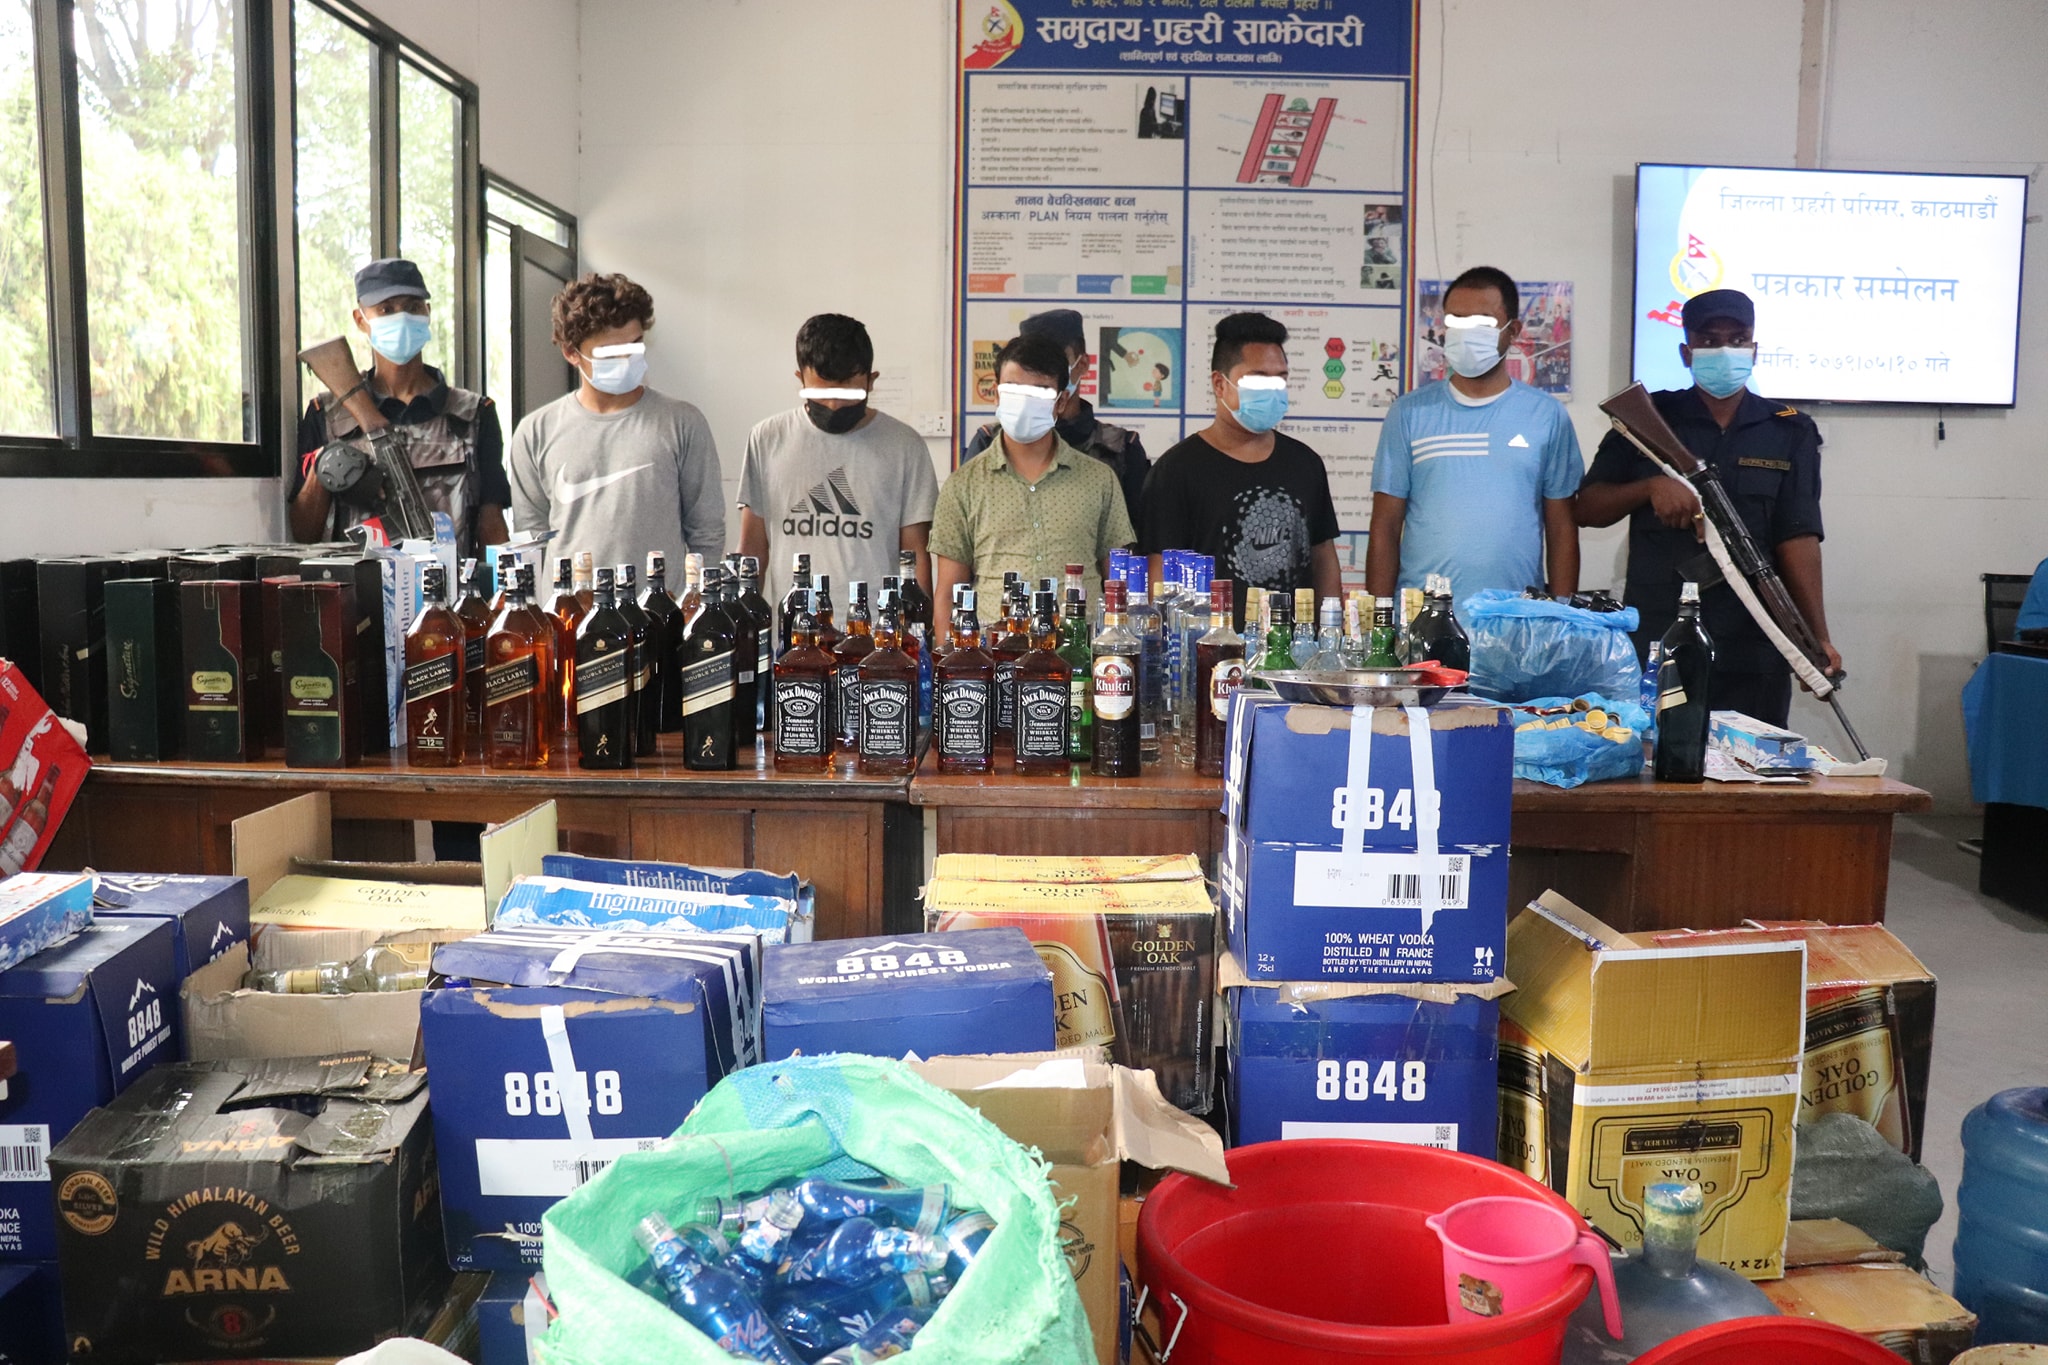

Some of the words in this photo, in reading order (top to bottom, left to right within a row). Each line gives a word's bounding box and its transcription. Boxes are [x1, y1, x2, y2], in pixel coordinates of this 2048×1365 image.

[1036, 12, 1224, 48] समुदाय-प्रहरी
[1233, 13, 1365, 47] साझेदारी
[1015, 196, 1043, 206] मानव
[1720, 187, 1784, 212] जिल्ला
[1791, 191, 1835, 214] प्रहरी
[1029, 211, 1059, 222] PLAN
[1065, 209, 1092, 221] नियम
[1098, 211, 1128, 222] पालना
[1752, 272, 1845, 300] पत्रकार
[1853, 266, 1959, 302] सम्मेलन
[1925, 352, 1950, 372] गते
[1326, 365, 1342, 373] GO
[783, 513, 873, 539] adidas
[1254, 527, 1291, 544] NIKE
[711, 662, 731, 673] BLACK
[408, 674, 429, 685] BLACK
[430, 667, 451, 677] LABEL
[507, 669, 529, 681] LABEL
[841, 674, 857, 688] JACK
[996, 671, 1013, 683] JACK
[1096, 678, 1131, 692] Khukri
[777, 689, 795, 703] JACK
[862, 690, 880, 704] JACK
[942, 690, 959, 704] JACK
[1021, 692, 1039, 706] JACK
[357, 886, 431, 898] GOLDEN
[1023, 886, 1105, 894] GOLDEN
[368, 895, 405, 904] OAK
[588, 891, 701, 917] Highlander
[259, 906, 296, 917] Batch
[1132, 940, 1196, 952] GOLDEN
[1324, 933, 1353, 944] 100%
[1358, 933, 1394, 945] WHEAT
[1399, 934, 1435, 946] VODKA
[1147, 953, 1180, 964] OAK
[1258, 953, 1268, 962] 12
[1323, 946, 1373, 957] DISTILLED
[1379, 947, 1389, 957] IN
[1396, 948, 1433, 958] FRANCE
[836, 950, 968, 974] 8848
[1257, 963, 1275, 972] 75cl
[798, 971, 881, 985] WORLD'S
[883, 967, 948, 979] PUREST
[952, 961, 1012, 973] VODKA
[1363, 966, 1379, 974] THE
[1473, 967, 1482, 976] 18
[1484, 968, 1494, 977] Kg
[128, 998, 161, 1049] 8848
[1815, 1057, 1861, 1087] OAK
[1316, 1060, 1426, 1101] 8848
[1801, 1069, 1880, 1110] GOLDEN
[1630, 1160, 1652, 1169] MALT
[1655, 1157, 1692, 1167] BLENDED
[1694, 1155, 1732, 1166] PREMIUM
[63, 1177, 94, 1198] LONDON
[146, 1218, 169, 1260] WILD
[166, 1186, 269, 1219] HIMALAYAN
[268, 1213, 301, 1256] BEER
[1740, 1260, 1749, 1269] x
[1754, 1258, 1771, 1270] 12
[163, 1266, 290, 1296] ARNA
